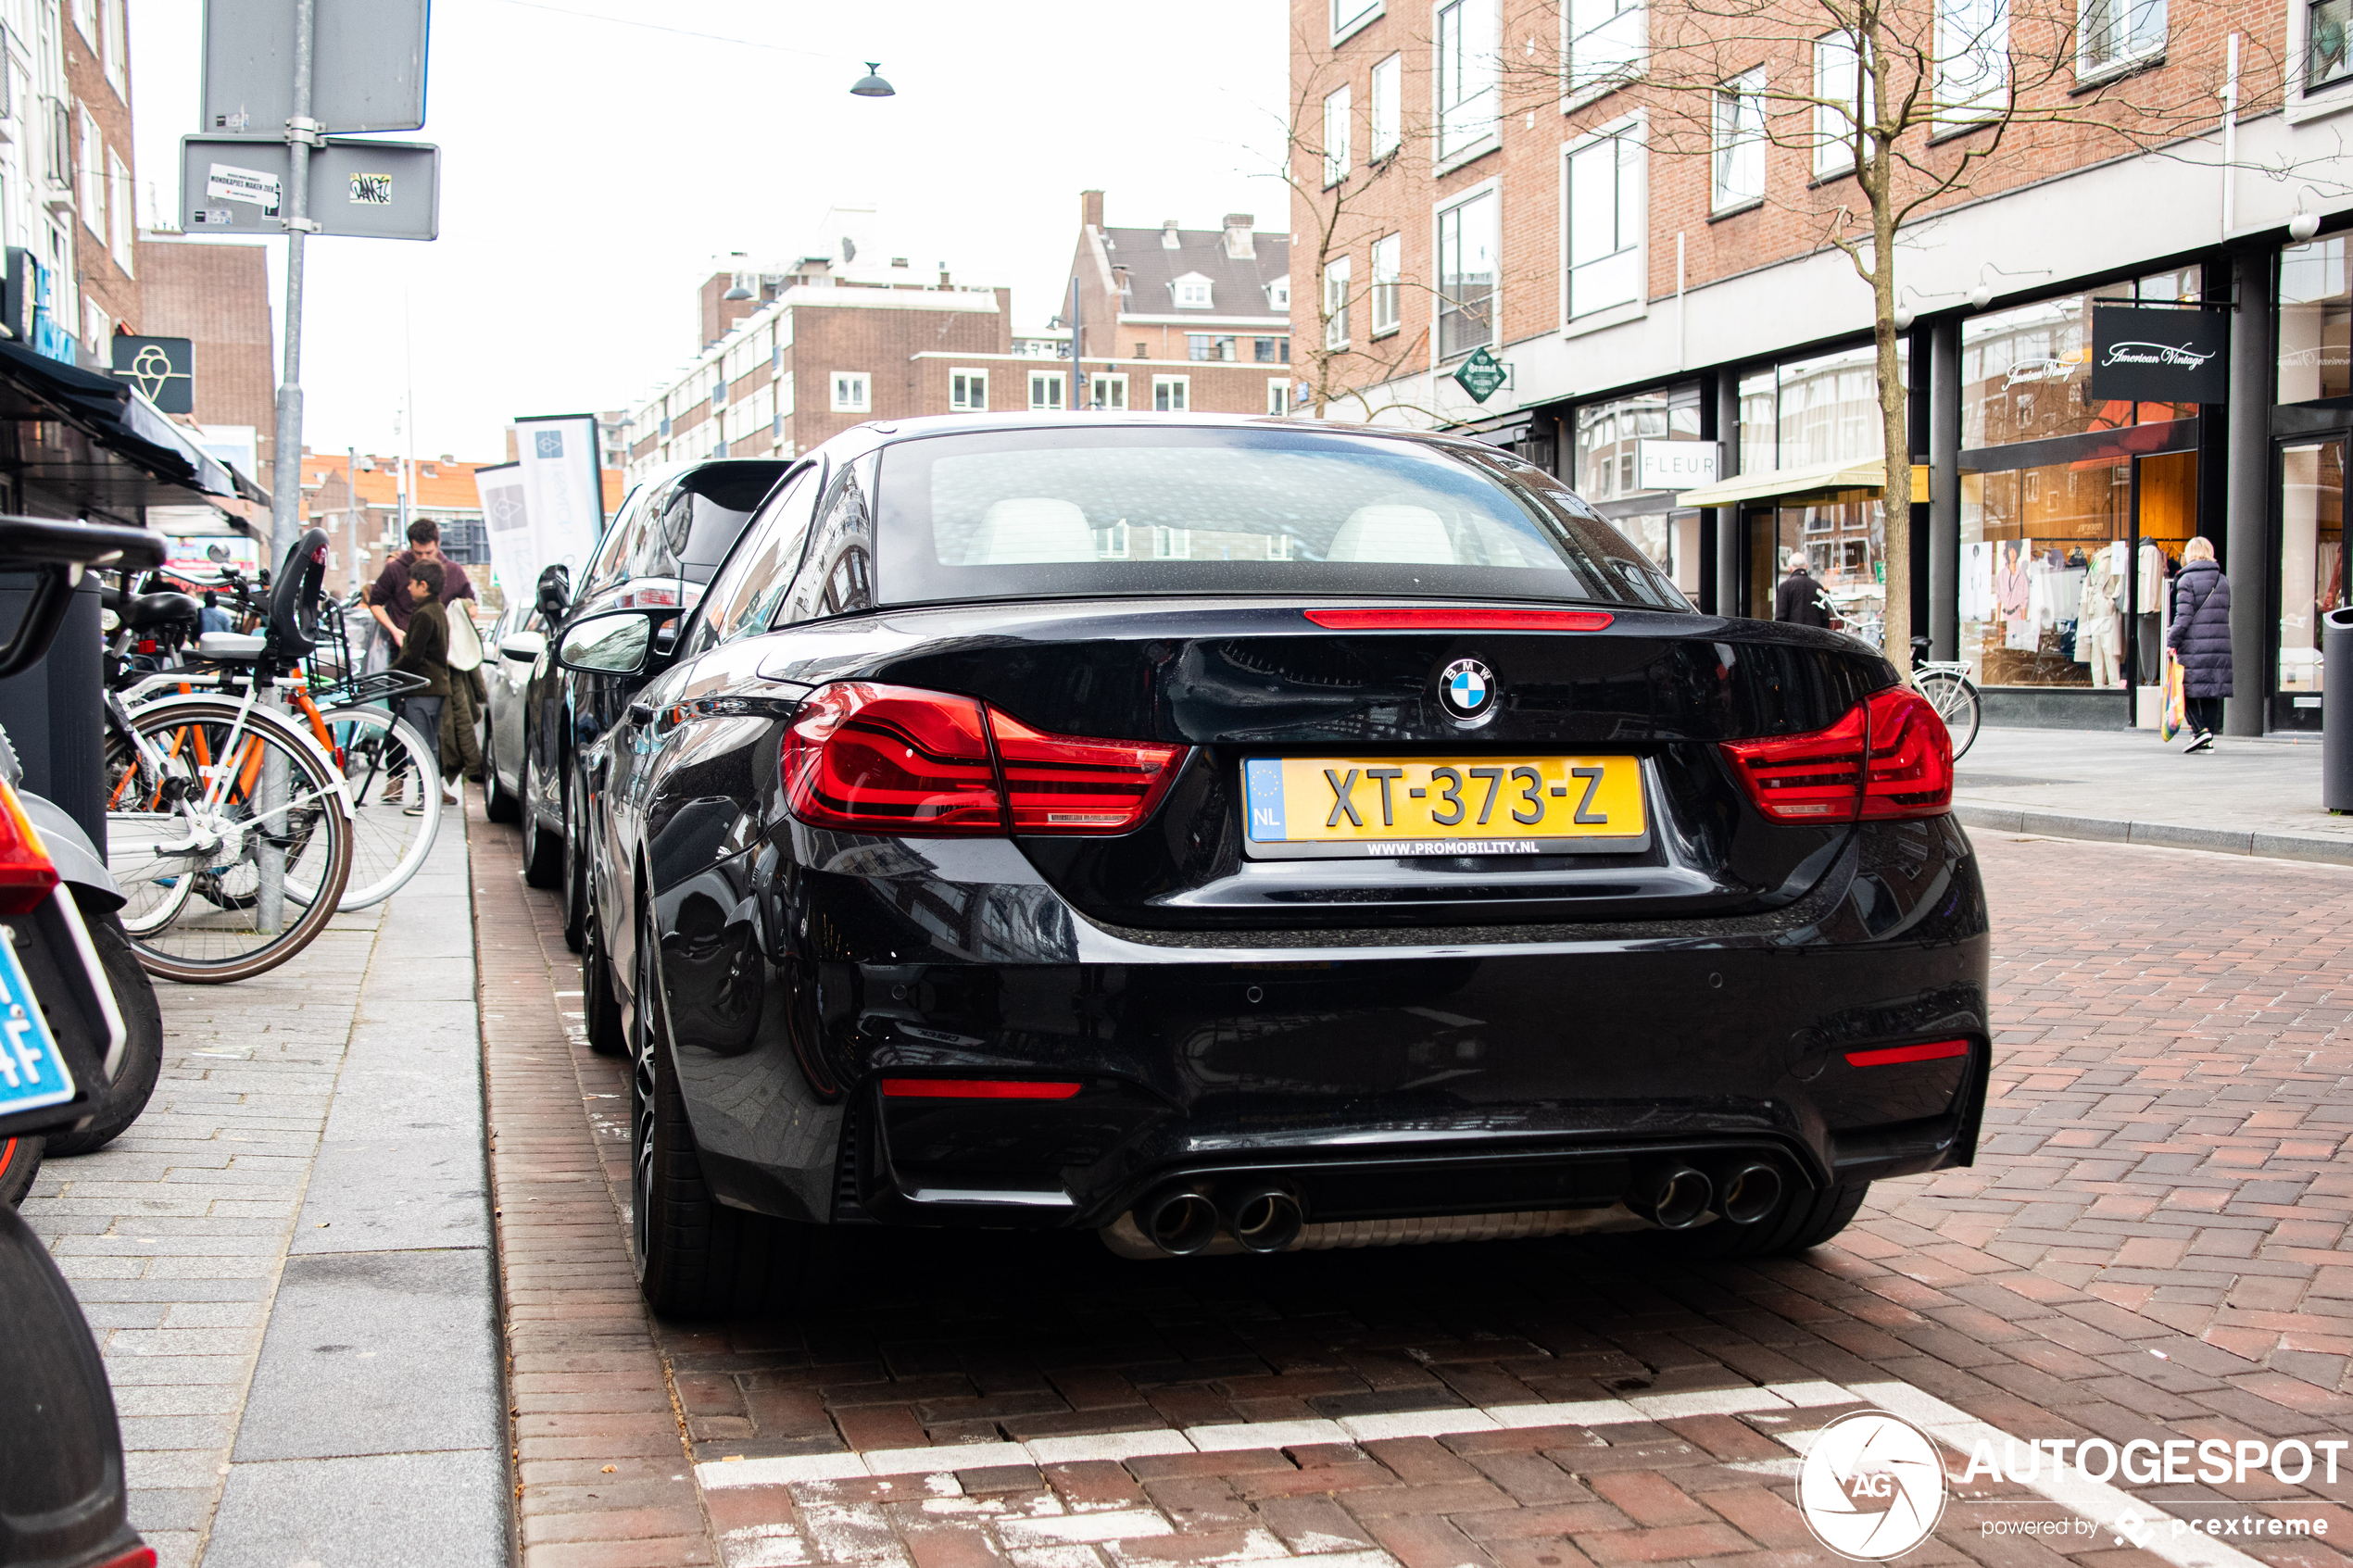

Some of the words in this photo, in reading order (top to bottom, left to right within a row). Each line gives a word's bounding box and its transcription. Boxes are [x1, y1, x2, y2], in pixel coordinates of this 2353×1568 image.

[245, 181, 263, 191] MAKEN
[263, 184, 275, 193] ZIEK
[2101, 342, 2160, 367] American
[2160, 342, 2216, 370] Vintage
[2001, 358, 2044, 392] American
[2043, 350, 2084, 383] Vintage
[1645, 457, 1714, 473] FLEUR
[1445, 661, 1491, 681] BMW
[1324, 767, 1608, 828] XT-373-Z
[1253, 808, 1280, 826] NL
[1367, 842, 1540, 855] WWW.PROMOBILITY.NL
